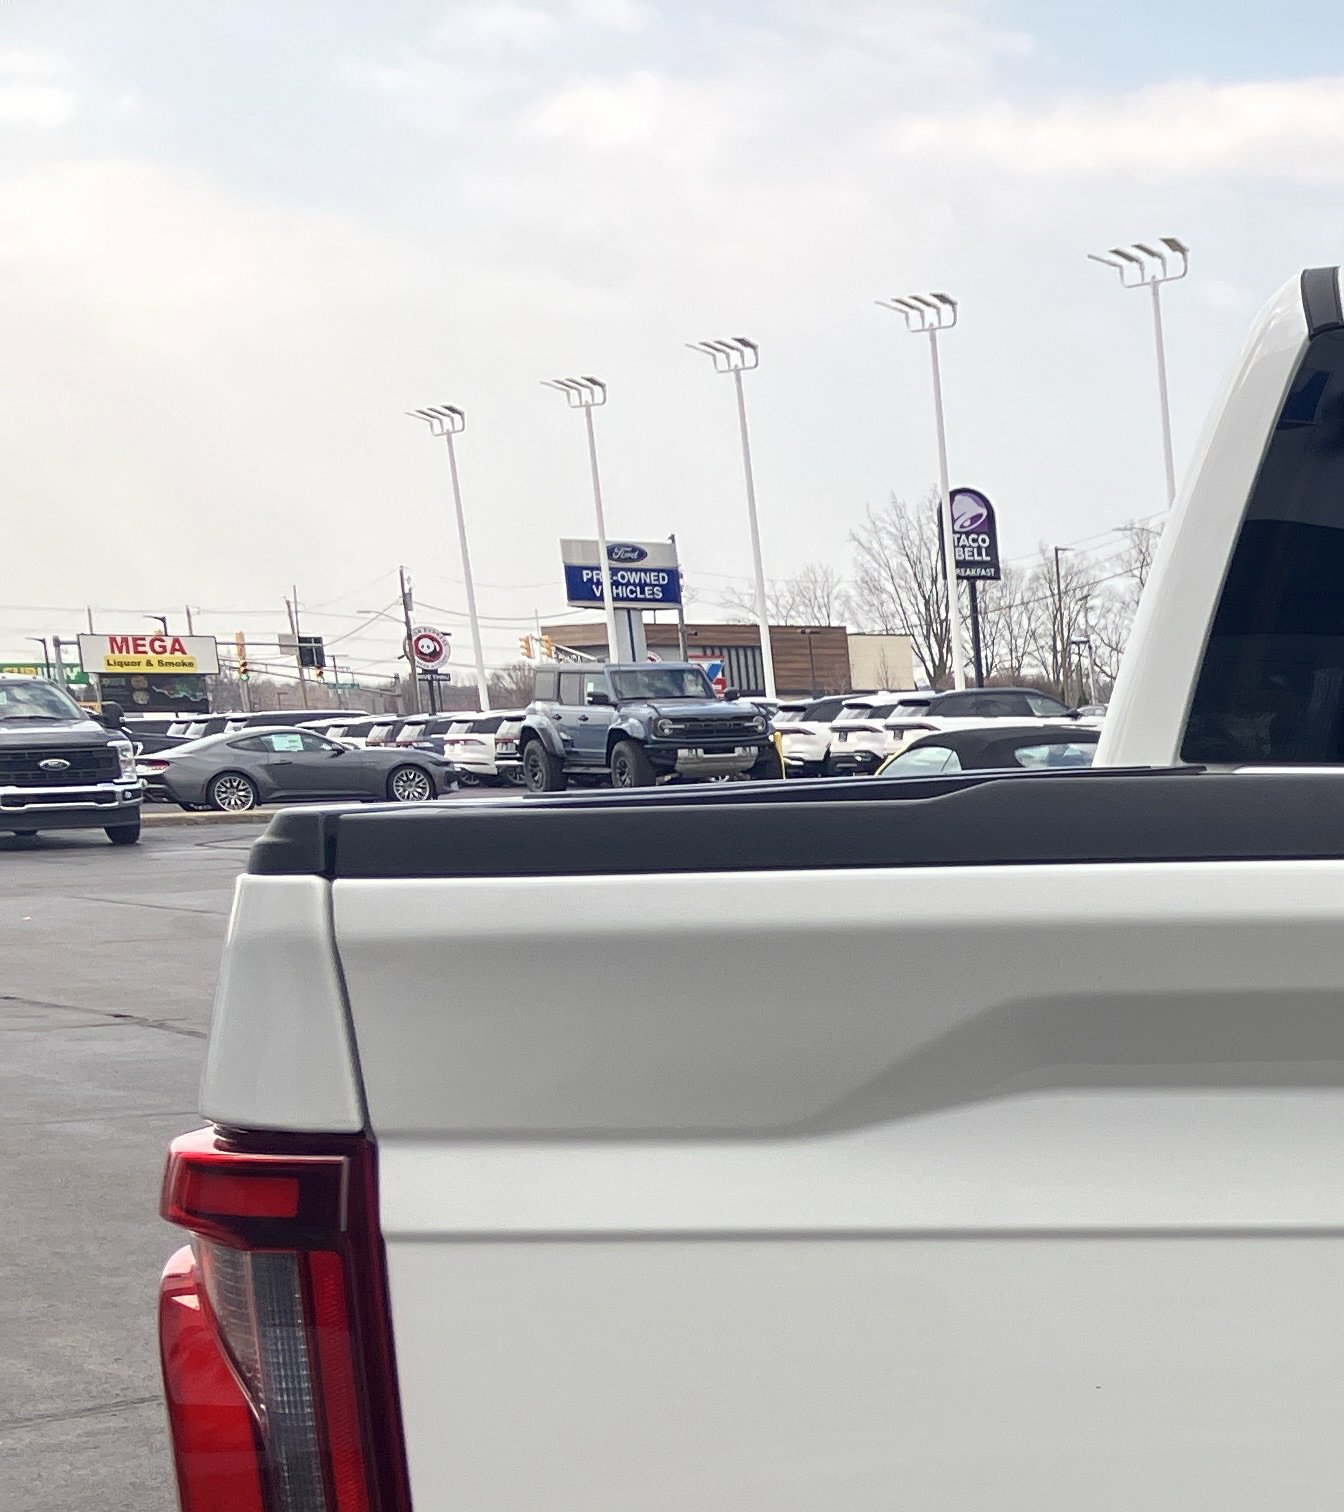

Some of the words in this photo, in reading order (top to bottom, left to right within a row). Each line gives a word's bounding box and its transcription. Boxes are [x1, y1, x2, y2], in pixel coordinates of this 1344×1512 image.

[953, 533, 990, 547] TACO
[612, 546, 640, 560] Ford
[955, 547, 991, 560] BELL
[954, 567, 995, 577] REAKFAST
[592, 584, 663, 599] VHICLES
[108, 636, 188, 655] MEGA
[106, 659, 141, 668] Liquor
[146, 659, 153, 667] &
[157, 659, 194, 668] Smoke
